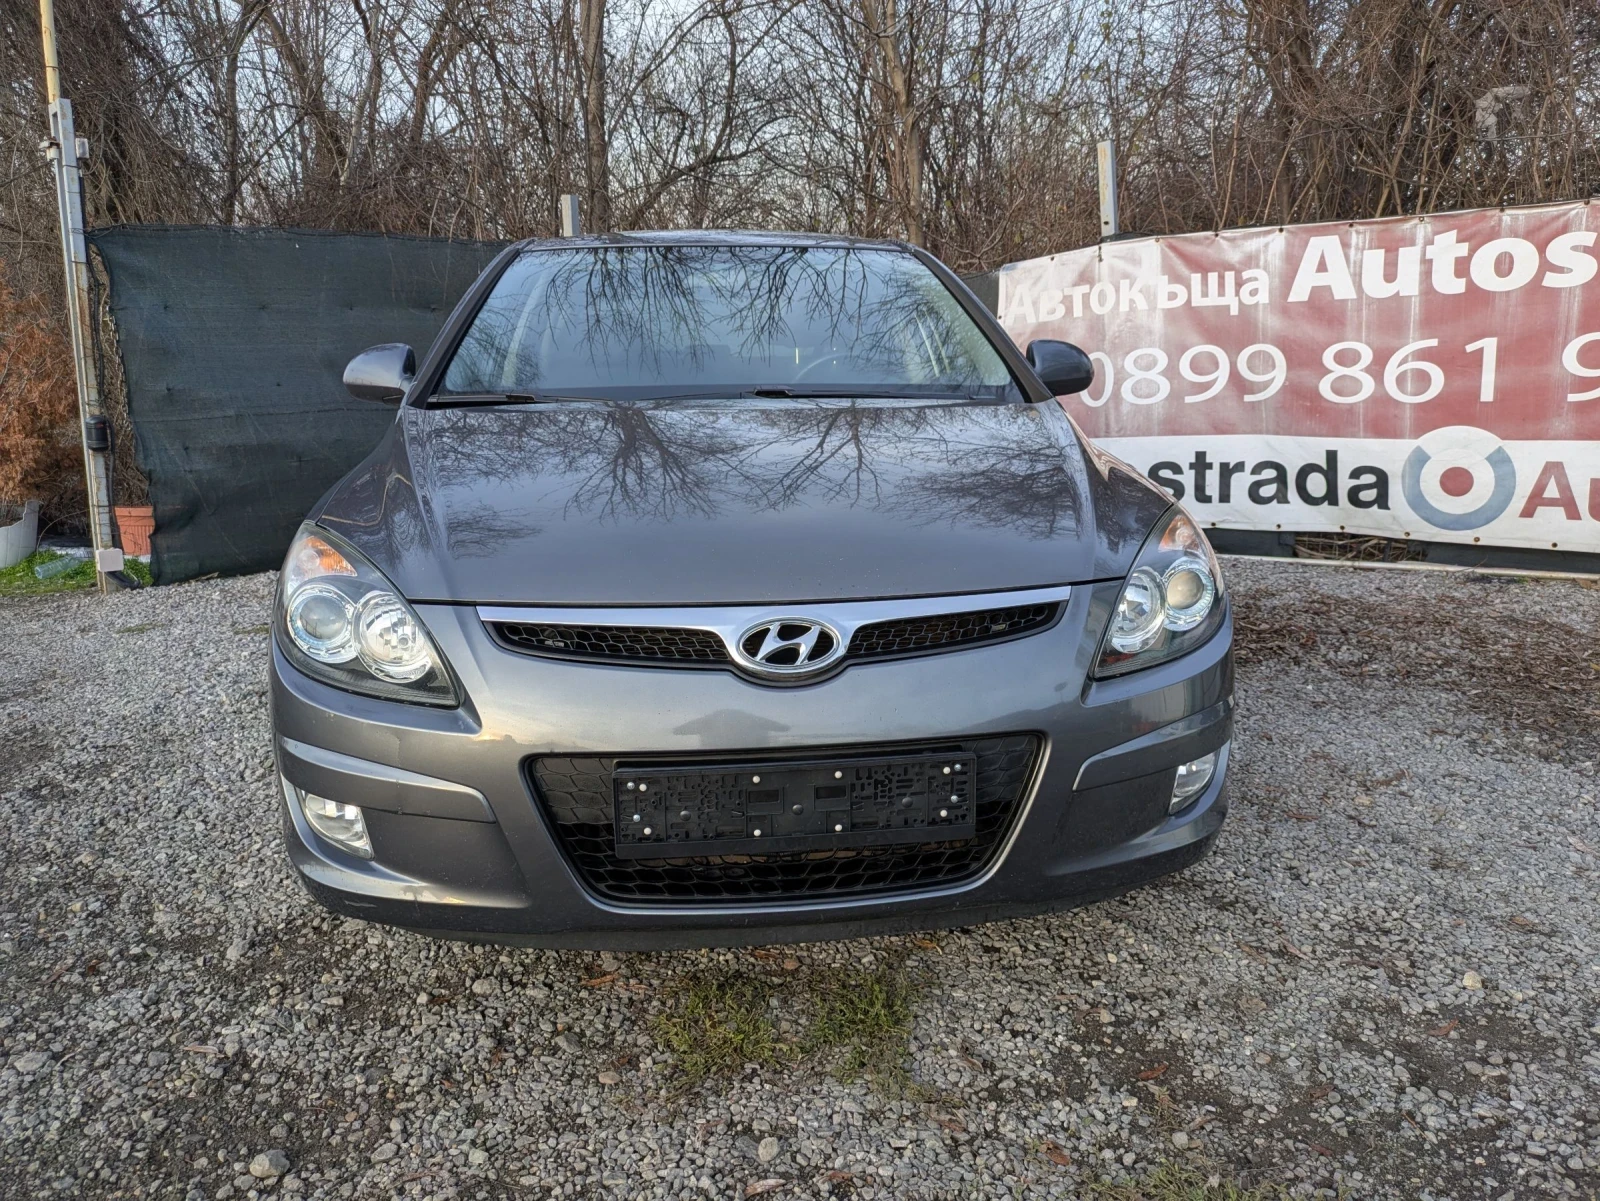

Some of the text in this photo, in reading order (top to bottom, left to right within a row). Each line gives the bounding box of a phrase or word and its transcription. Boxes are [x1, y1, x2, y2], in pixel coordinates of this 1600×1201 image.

[1006, 230, 1599, 326] Автокъща Autos
[1079, 343, 1287, 407] 0899
[1318, 337, 1498, 404] 861
[1147, 450, 1600, 522] strada A
